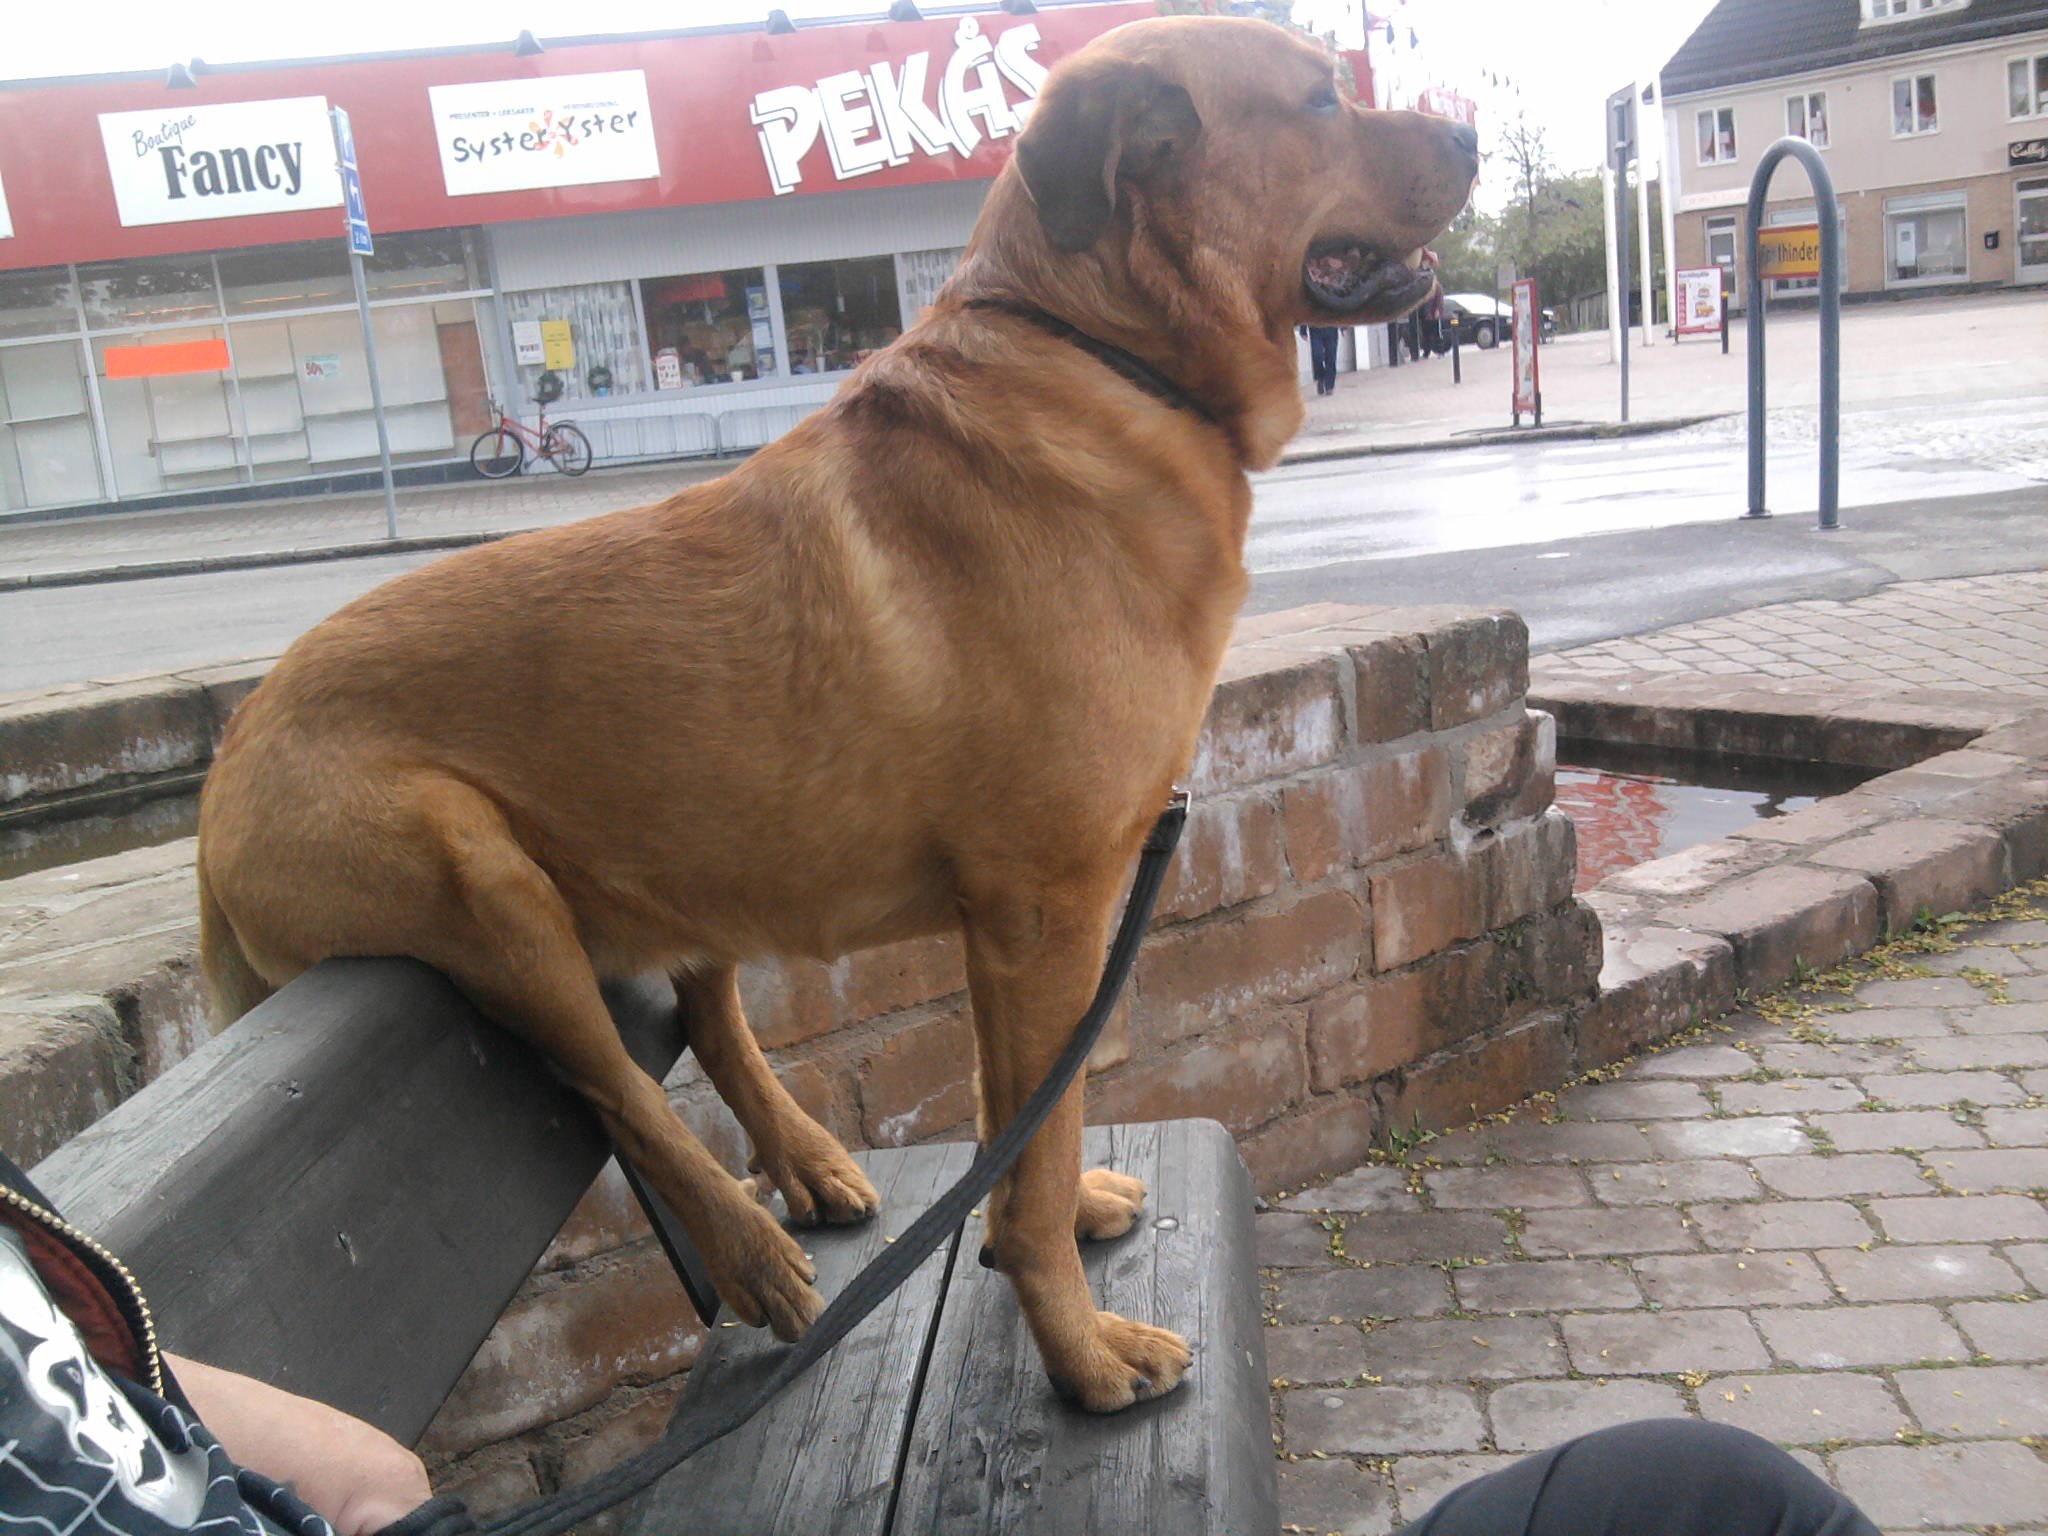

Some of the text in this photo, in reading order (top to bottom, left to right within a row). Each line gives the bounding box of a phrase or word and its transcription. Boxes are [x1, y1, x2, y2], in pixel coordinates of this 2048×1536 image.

[749, 16, 1050, 196] PEKÅS
[132, 113, 197, 158] Boutique
[452, 110, 638, 163] Syster Yster
[157, 141, 303, 200] Fancy
[1760, 241, 1819, 264] thinder
